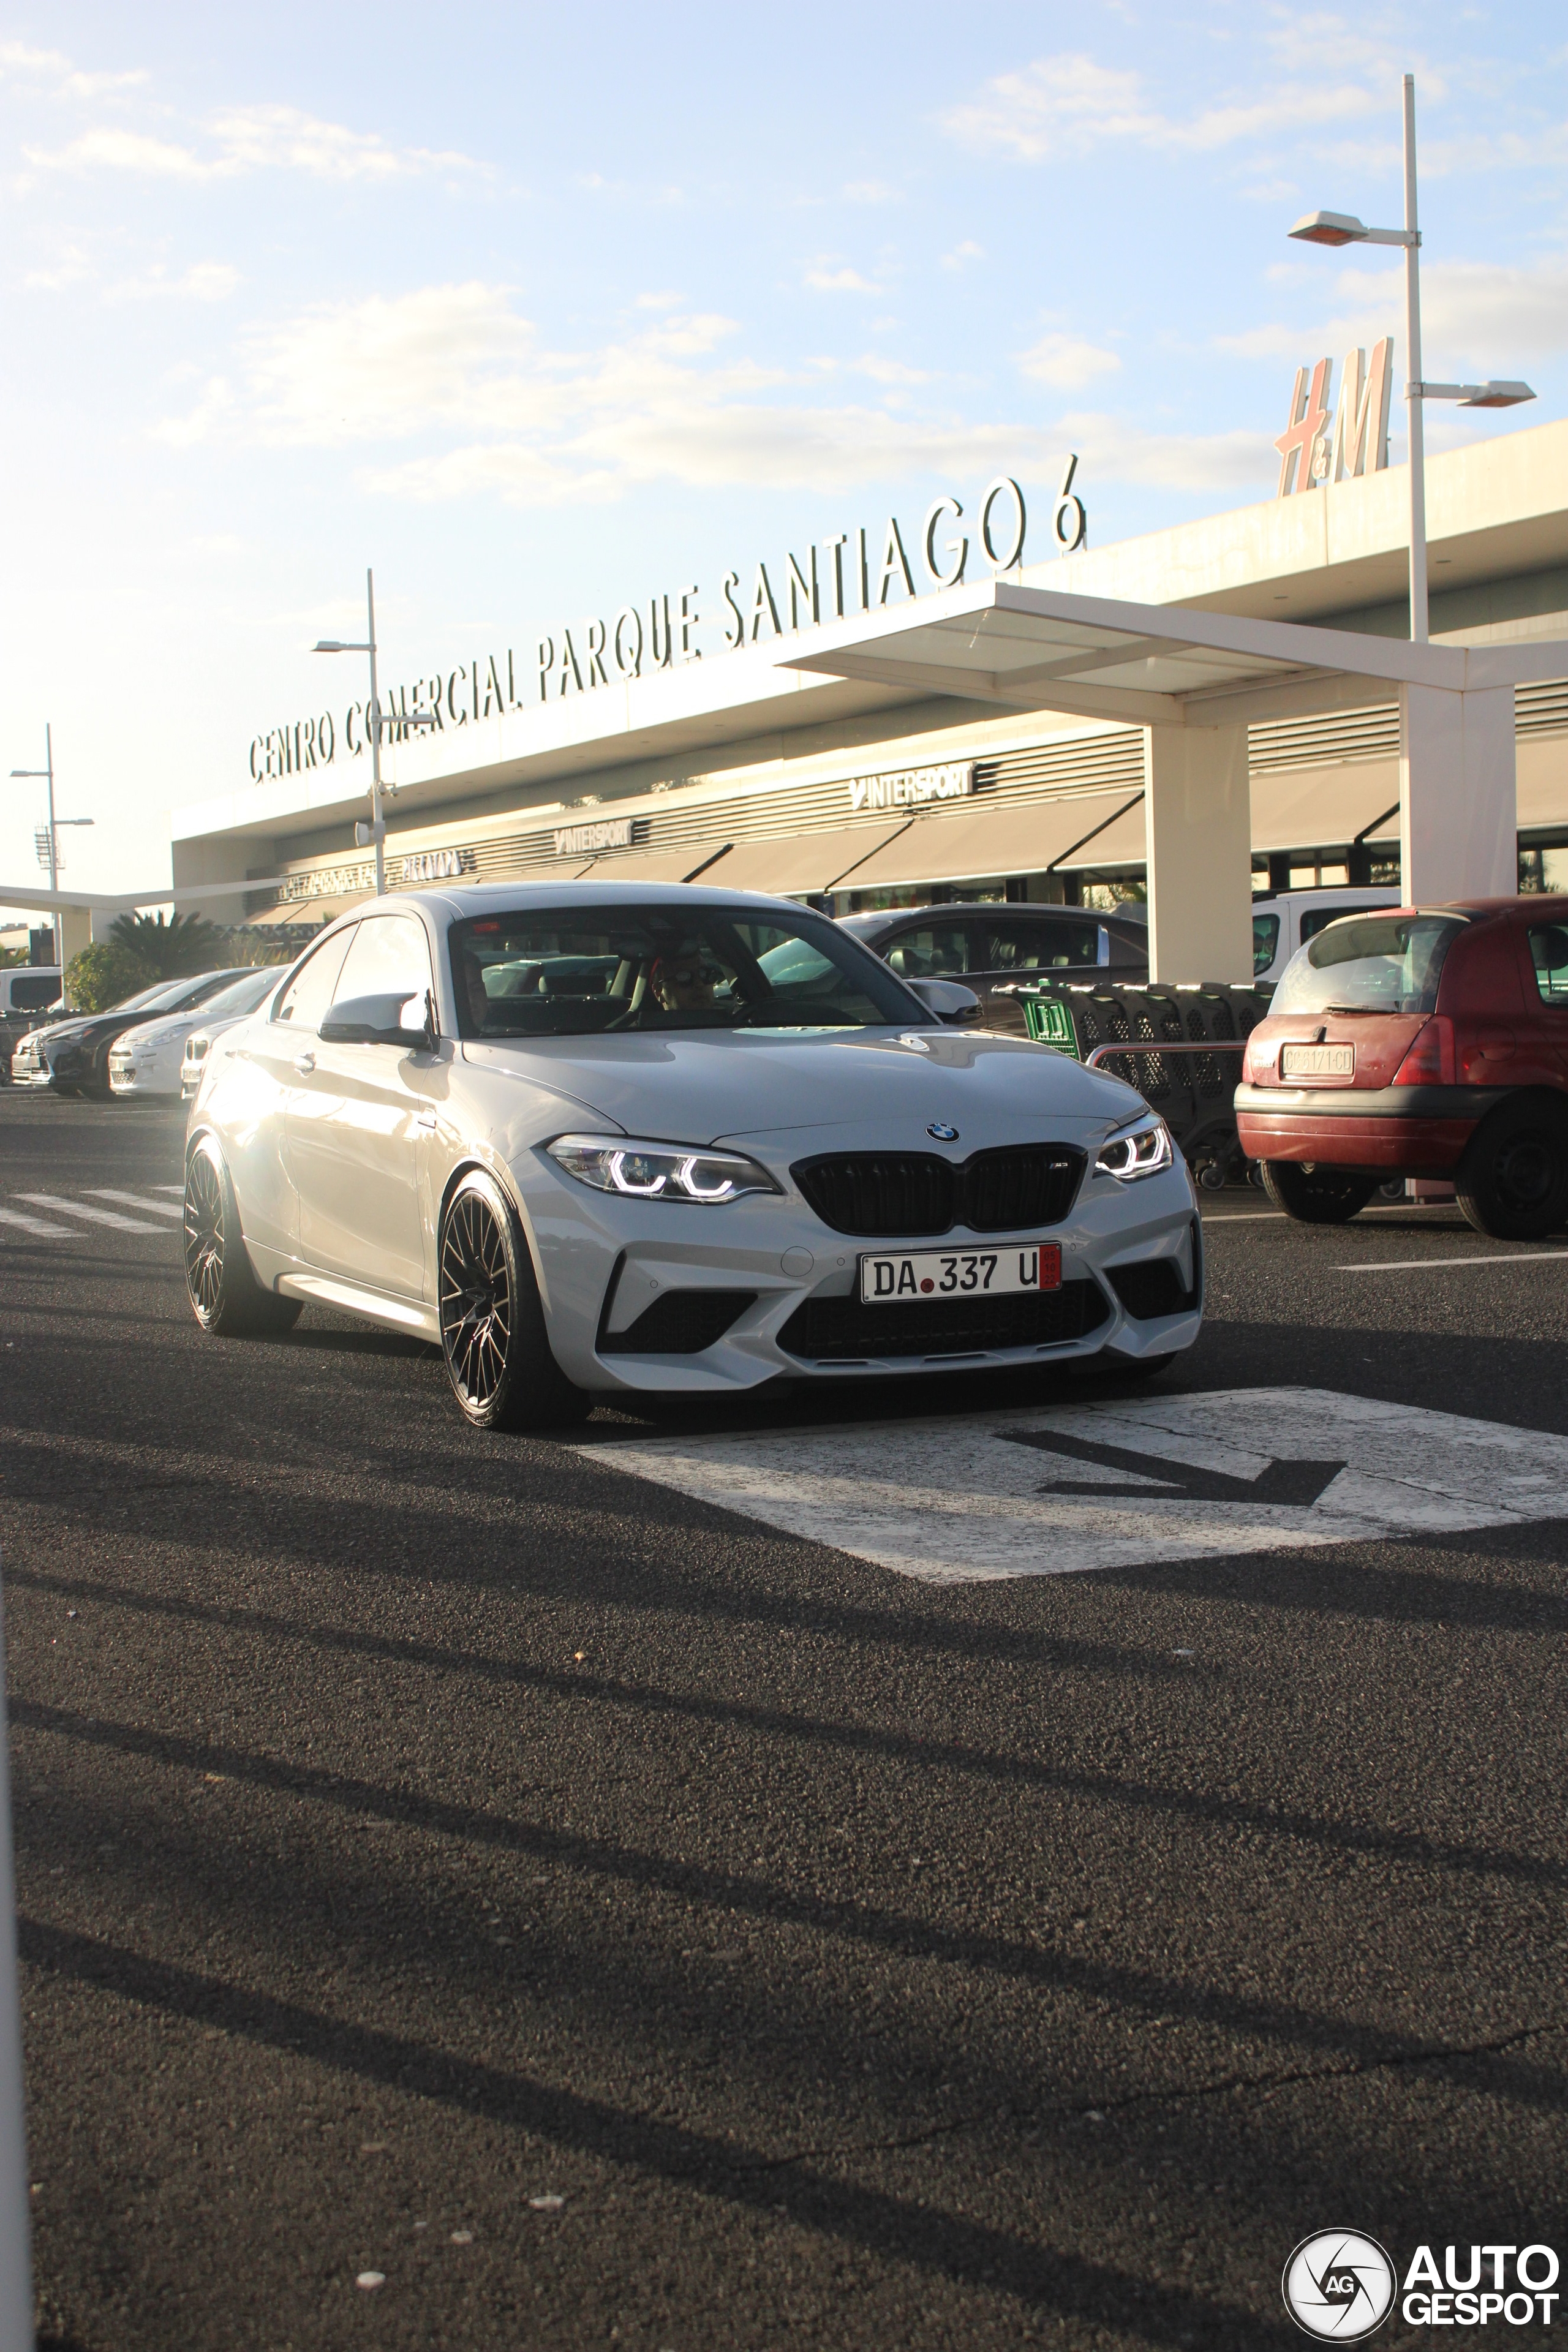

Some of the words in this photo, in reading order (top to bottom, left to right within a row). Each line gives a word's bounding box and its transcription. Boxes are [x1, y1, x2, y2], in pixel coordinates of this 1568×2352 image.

[1273, 336, 1394, 499] H&M
[249, 710, 335, 783] CENTRO
[346, 648, 522, 757] COMERCIAL
[537, 585, 702, 702] PARQUE
[721, 476, 1027, 650] SANTIAGO
[1052, 453, 1085, 552] 6
[867, 761, 976, 809] INTERSPORT
[565, 818, 633, 854] INTERSPORT
[873, 1260, 918, 1296] DA
[939, 1254, 998, 1292] 337
[1019, 1251, 1038, 1286] U
[1044, 1274, 1055, 1284] 22
